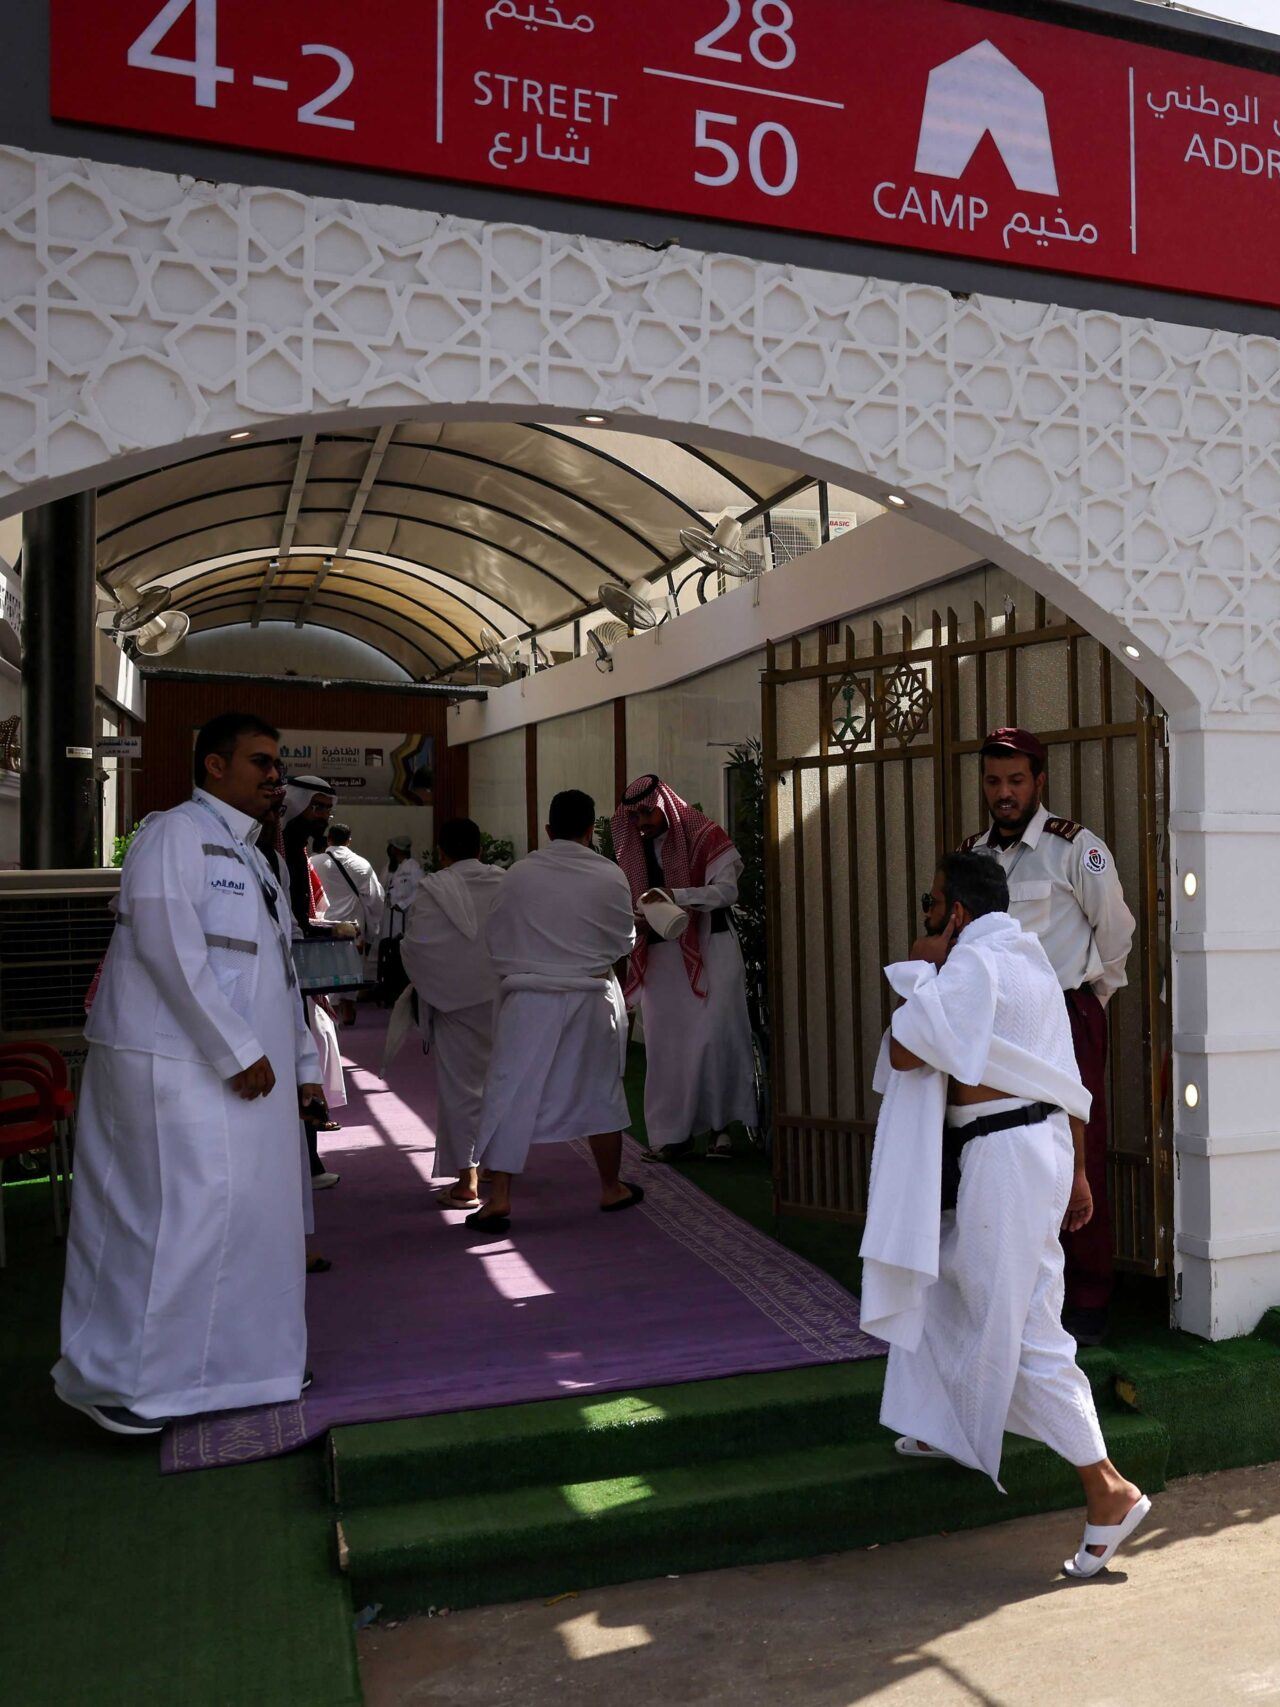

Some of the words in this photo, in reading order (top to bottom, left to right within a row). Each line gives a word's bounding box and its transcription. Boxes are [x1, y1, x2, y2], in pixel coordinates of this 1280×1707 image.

[695, 0, 796, 69] 28
[474, 71, 617, 126] STREET
[1146, 85, 1259, 126] الوطني
[489, 123, 590, 170] شارع
[695, 109, 798, 197] 50
[873, 182, 989, 231] CAMP
[1002, 208, 1098, 249] مخيم
